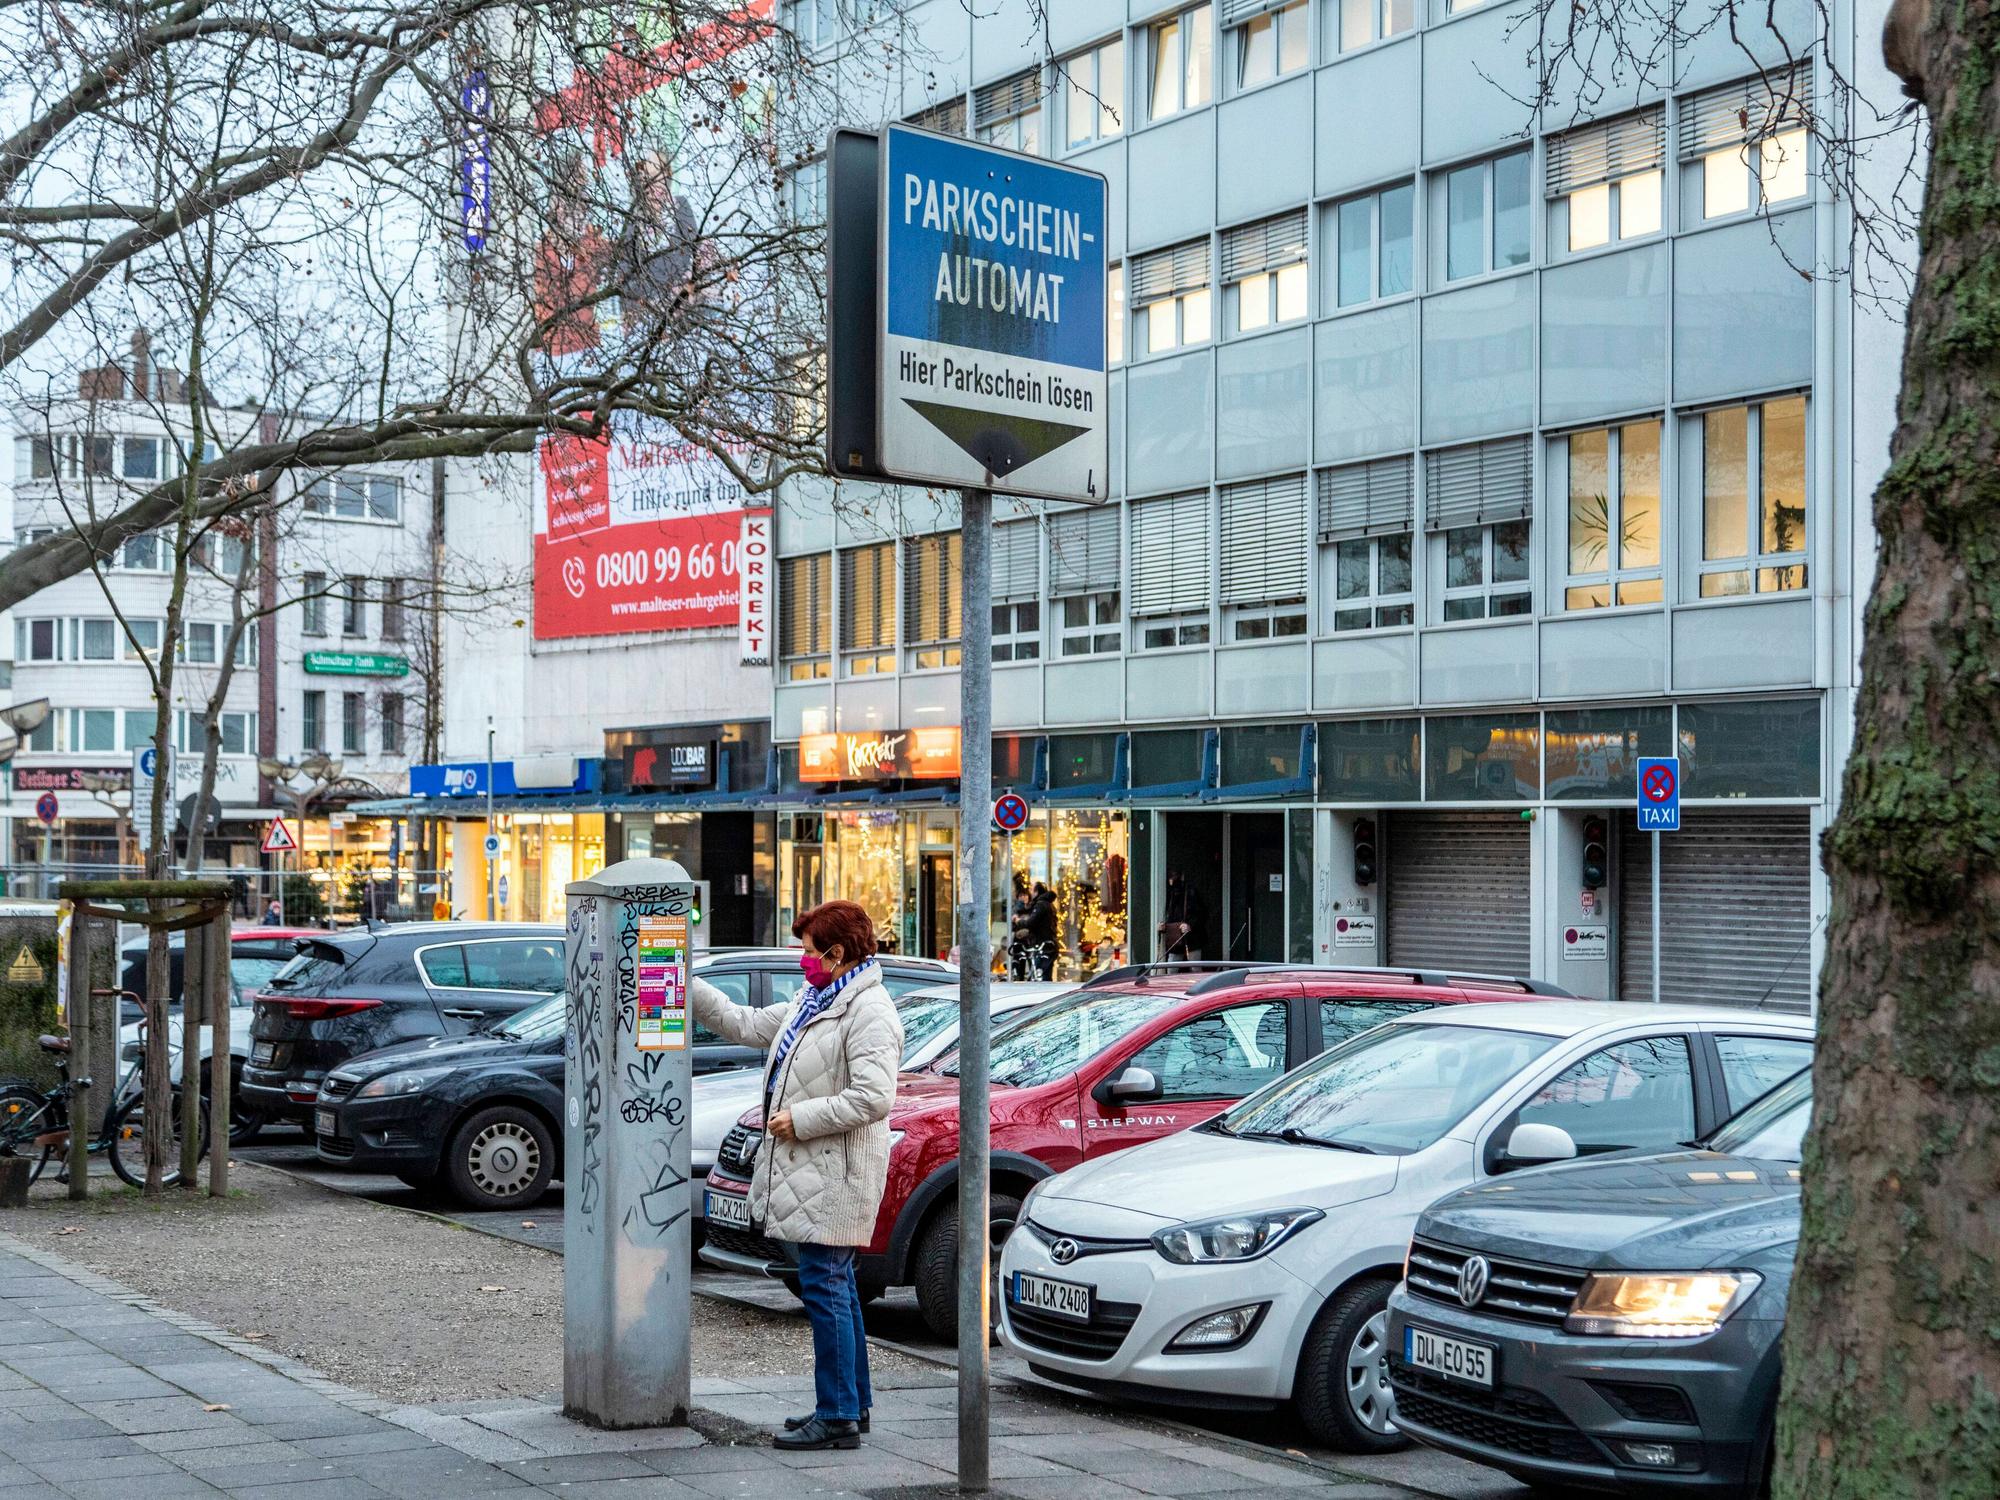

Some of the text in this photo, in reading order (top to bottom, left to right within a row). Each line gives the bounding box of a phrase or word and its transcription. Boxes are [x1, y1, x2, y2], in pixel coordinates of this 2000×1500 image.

[904, 173, 1095, 261] PARKSCHEIN-
[935, 252, 1064, 324] AUTOMAT
[899, 350, 1093, 413] Hier Parkschein lösen
[676, 480, 711, 507] rund
[1087, 469, 1096, 498] 4
[596, 550, 649, 588] 0800
[654, 546, 681, 583] 99
[687, 542, 715, 580] 66
[745, 522, 766, 652] KORREKT
[742, 657, 768, 667] MODE
[1642, 807, 1675, 823] TAXI
[1087, 1115, 1176, 1128] STEPWAY
[710, 1195, 719, 1215] DU
[723, 1199, 733, 1220] CK
[1021, 1277, 1088, 1314] DU CK 2408
[1417, 1334, 1485, 1379] DU EO 55
